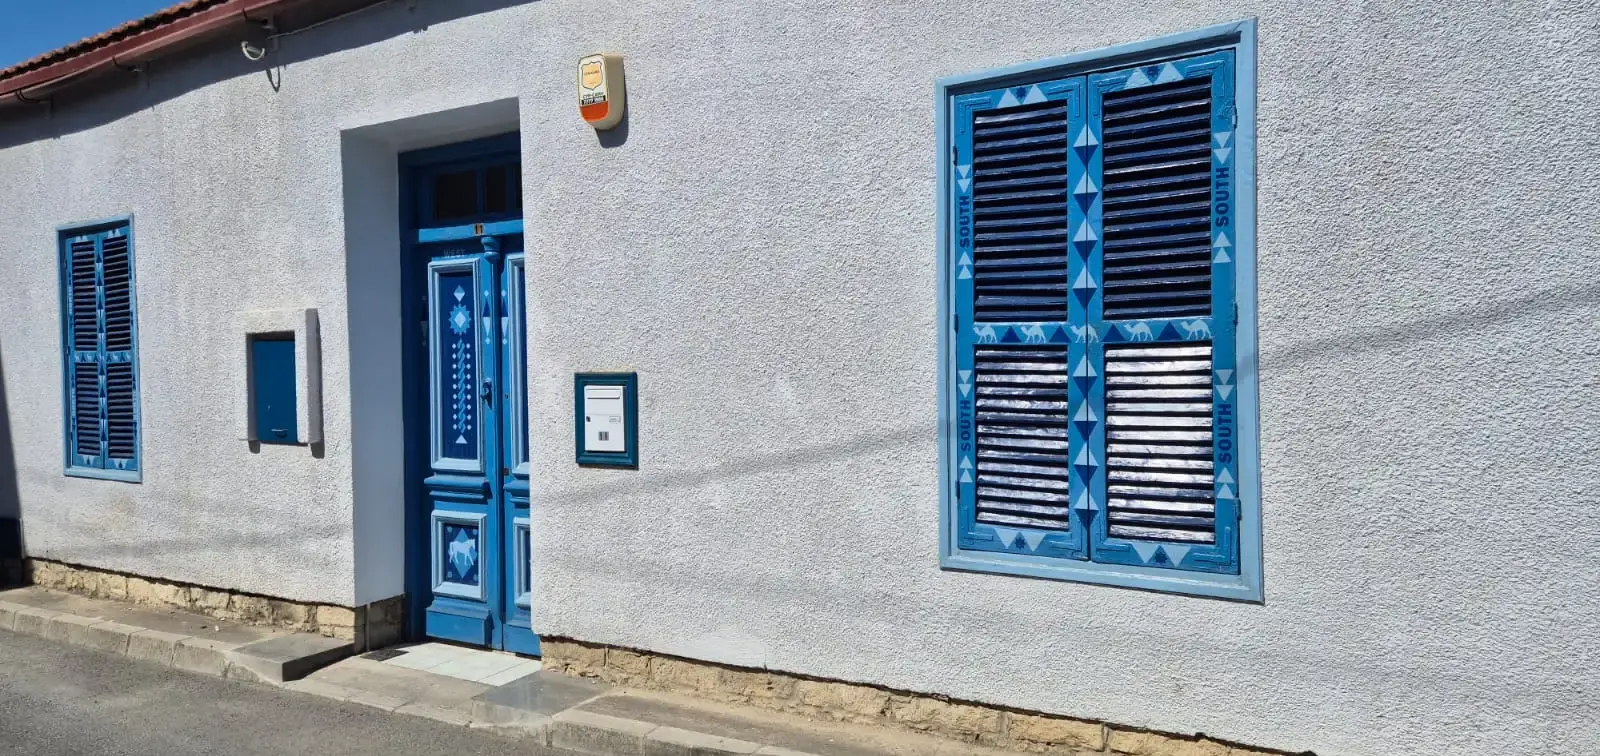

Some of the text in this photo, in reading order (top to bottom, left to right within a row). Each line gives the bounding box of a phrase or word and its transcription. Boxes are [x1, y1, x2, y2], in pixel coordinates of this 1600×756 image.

[960, 196, 970, 248] SOUTH
[1215, 167, 1230, 228] SOUTH
[443, 247, 466, 256] WEST
[475, 224, 483, 234] 11
[960, 400, 971, 452] SOUTH
[1218, 403, 1232, 464] SOUTH
